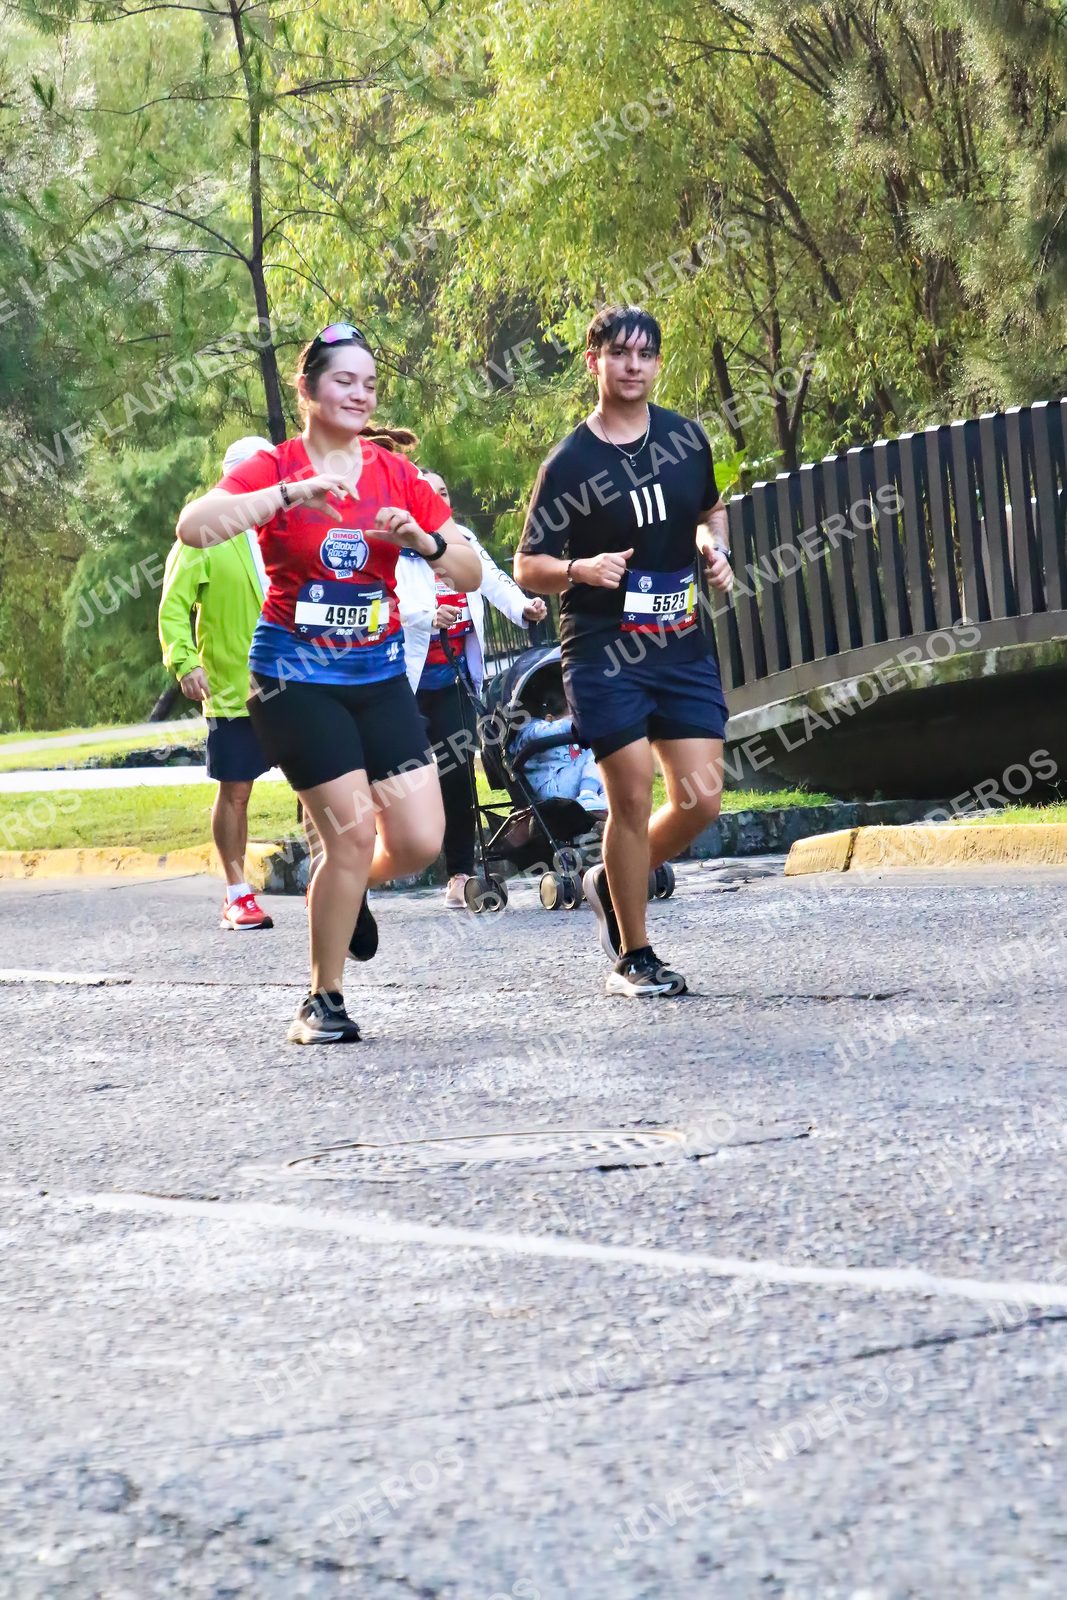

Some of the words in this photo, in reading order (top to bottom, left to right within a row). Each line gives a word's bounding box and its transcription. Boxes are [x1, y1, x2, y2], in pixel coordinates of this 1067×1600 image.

[327, 549, 348, 557] Race
[332, 541, 358, 551] Global
[652, 592, 686, 612] 5523
[325, 606, 368, 626] 4996
